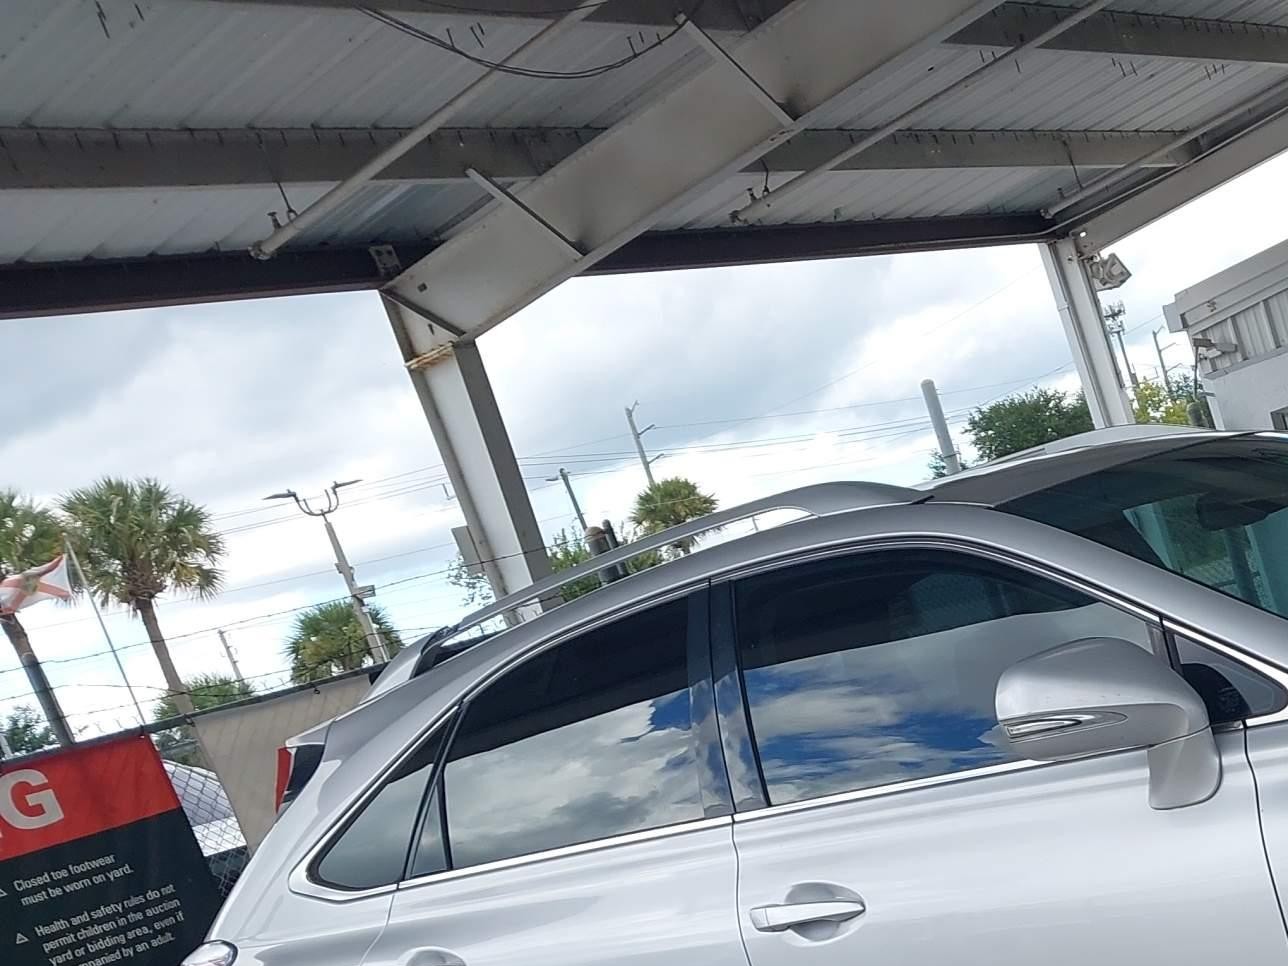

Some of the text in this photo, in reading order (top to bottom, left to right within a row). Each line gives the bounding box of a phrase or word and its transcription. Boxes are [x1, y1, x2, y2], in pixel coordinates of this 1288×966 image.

[13, 854, 116, 891] Closed toe footwear
[20, 863, 134, 906] must be worn on yard.
[34, 883, 176, 937] Health and safety rules do not
[42, 898, 181, 954] permit children in the auction
[74, 946, 87, 958] or
[86, 932, 127, 953] bidding
[127, 925, 153, 940] area,
[153, 915, 176, 930] even
[175, 909, 185, 922] if
[121, 945, 135, 958] by
[135, 940, 150, 953] an
[150, 931, 176, 948] adult.
